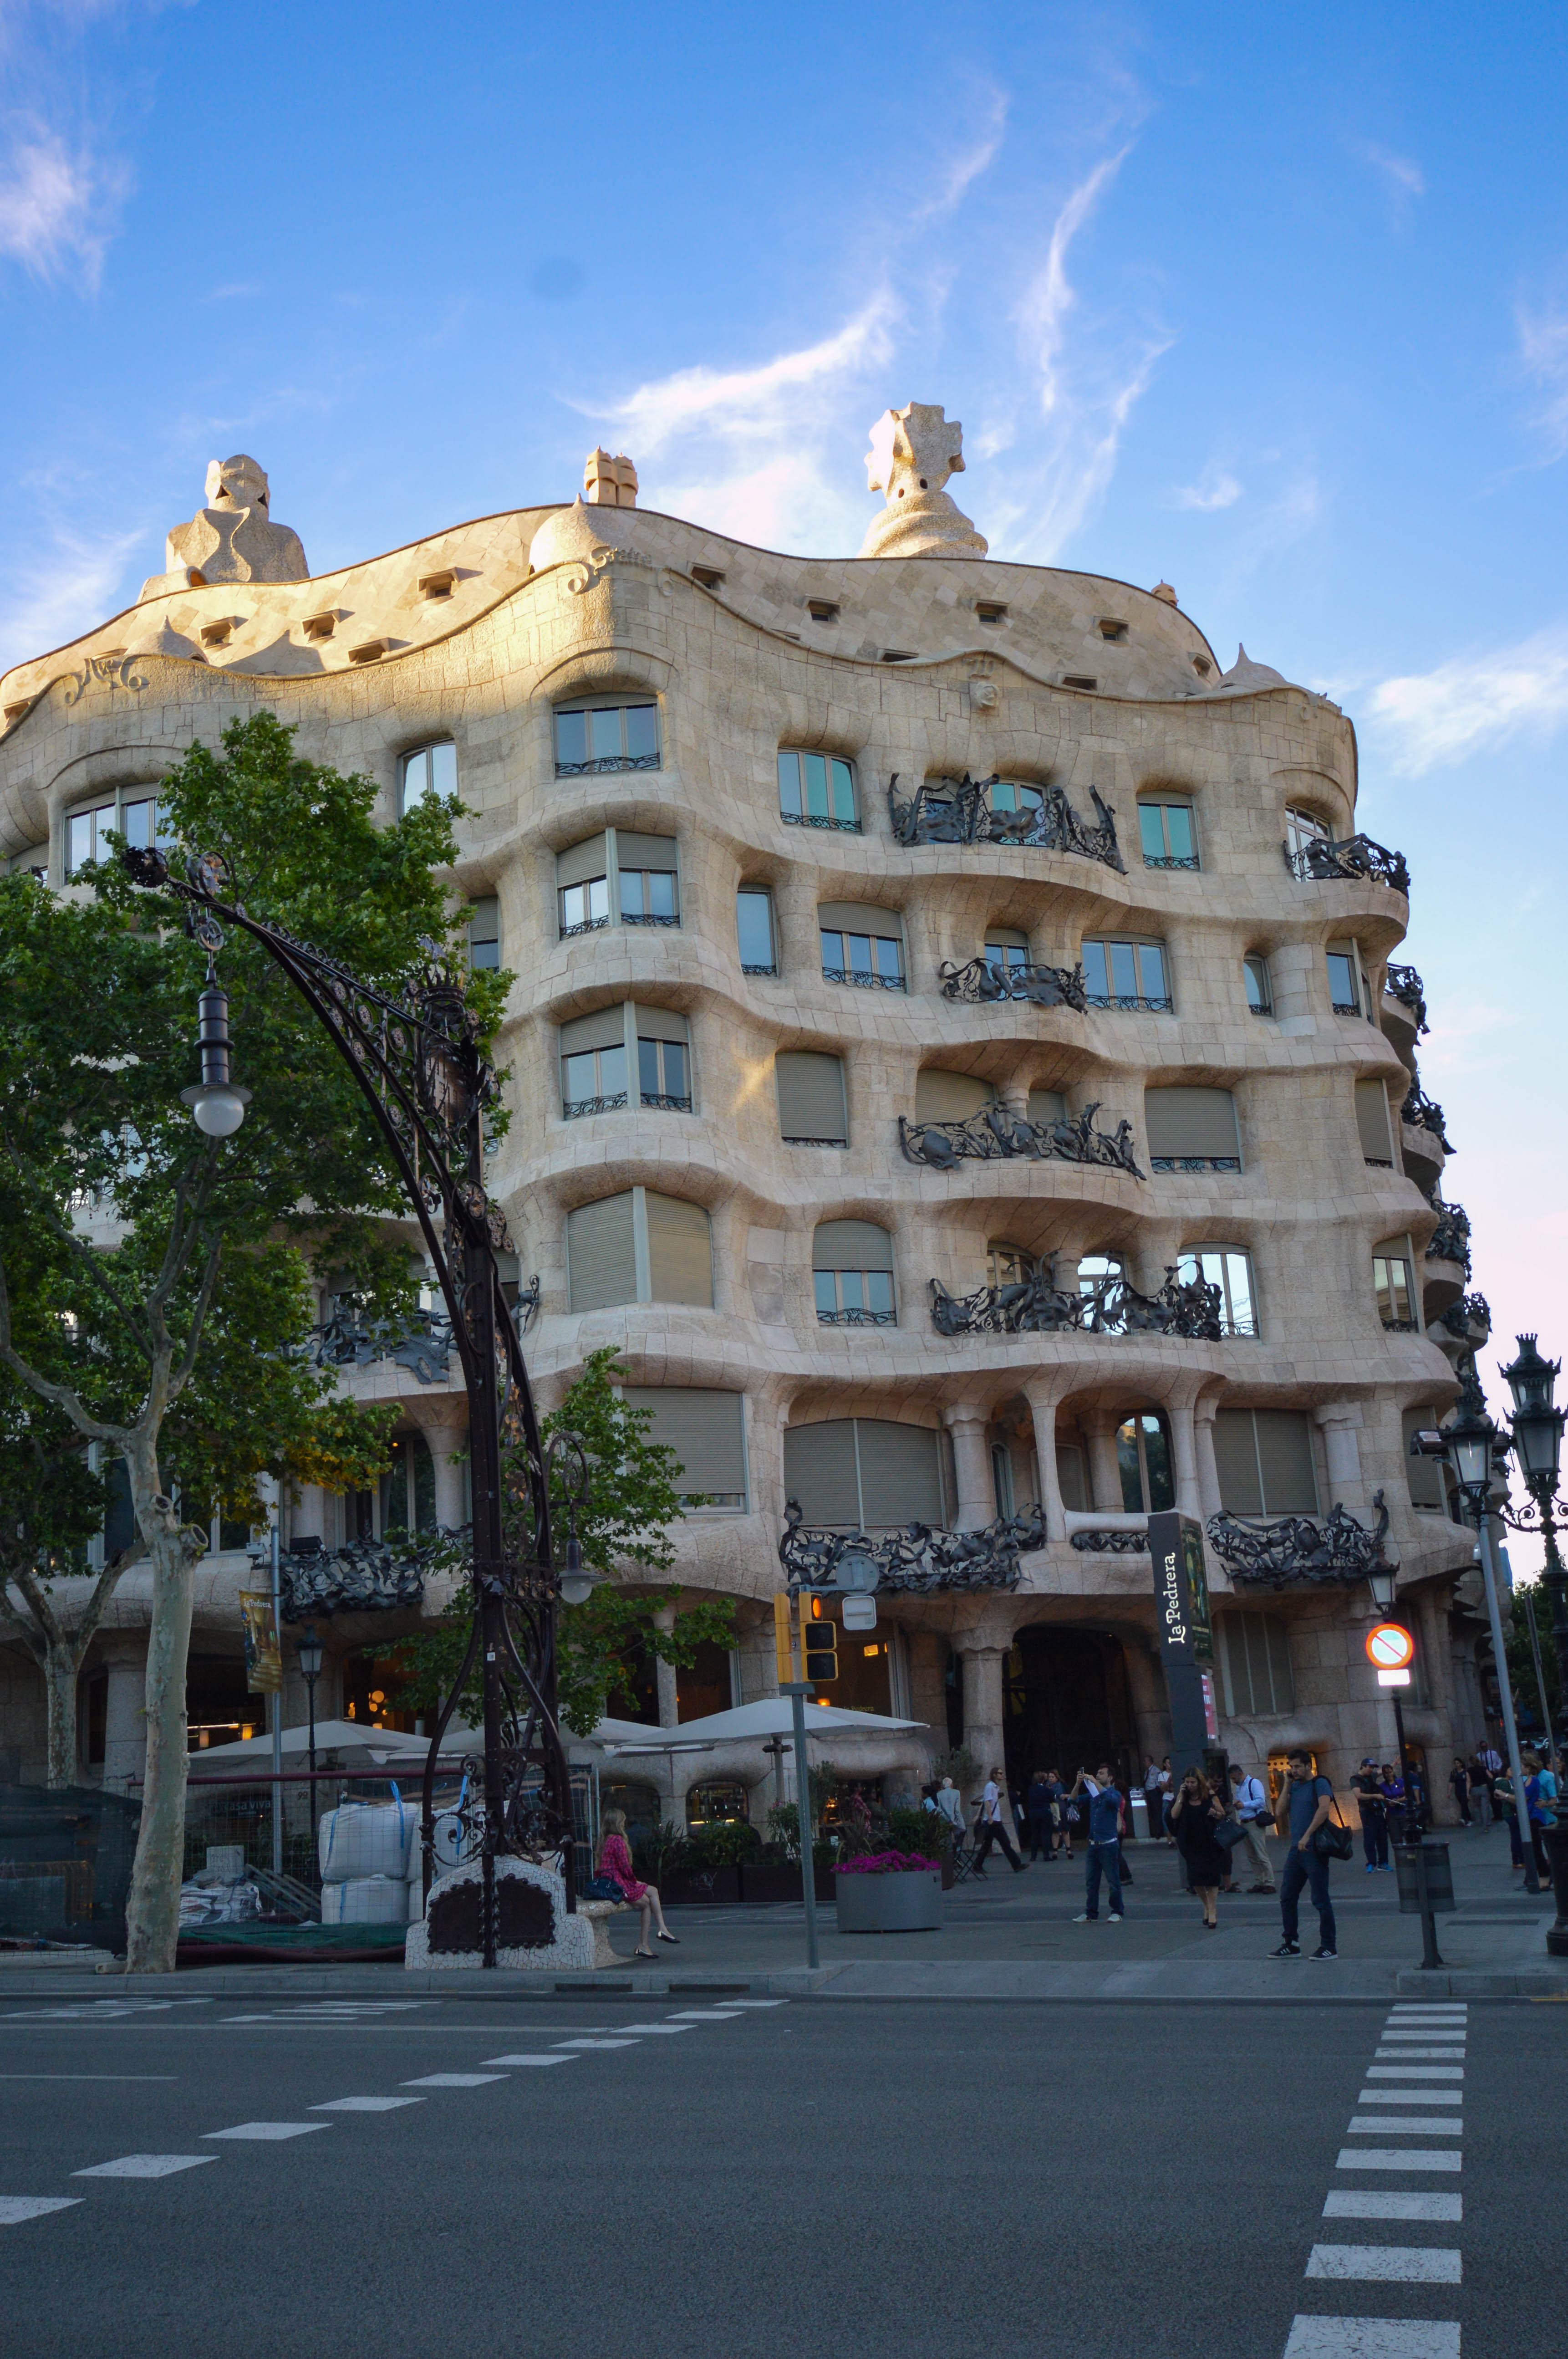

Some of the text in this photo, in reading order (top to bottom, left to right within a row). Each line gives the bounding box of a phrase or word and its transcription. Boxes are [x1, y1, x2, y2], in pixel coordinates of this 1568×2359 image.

[243, 1598, 272, 1608] La Pedrera
[1162, 1552, 1186, 1644] La Pedrera
[225, 1802, 247, 1811] asa
[0, 1997, 215, 2017] BUS
[216, 1998, 458, 2022] TAXI
